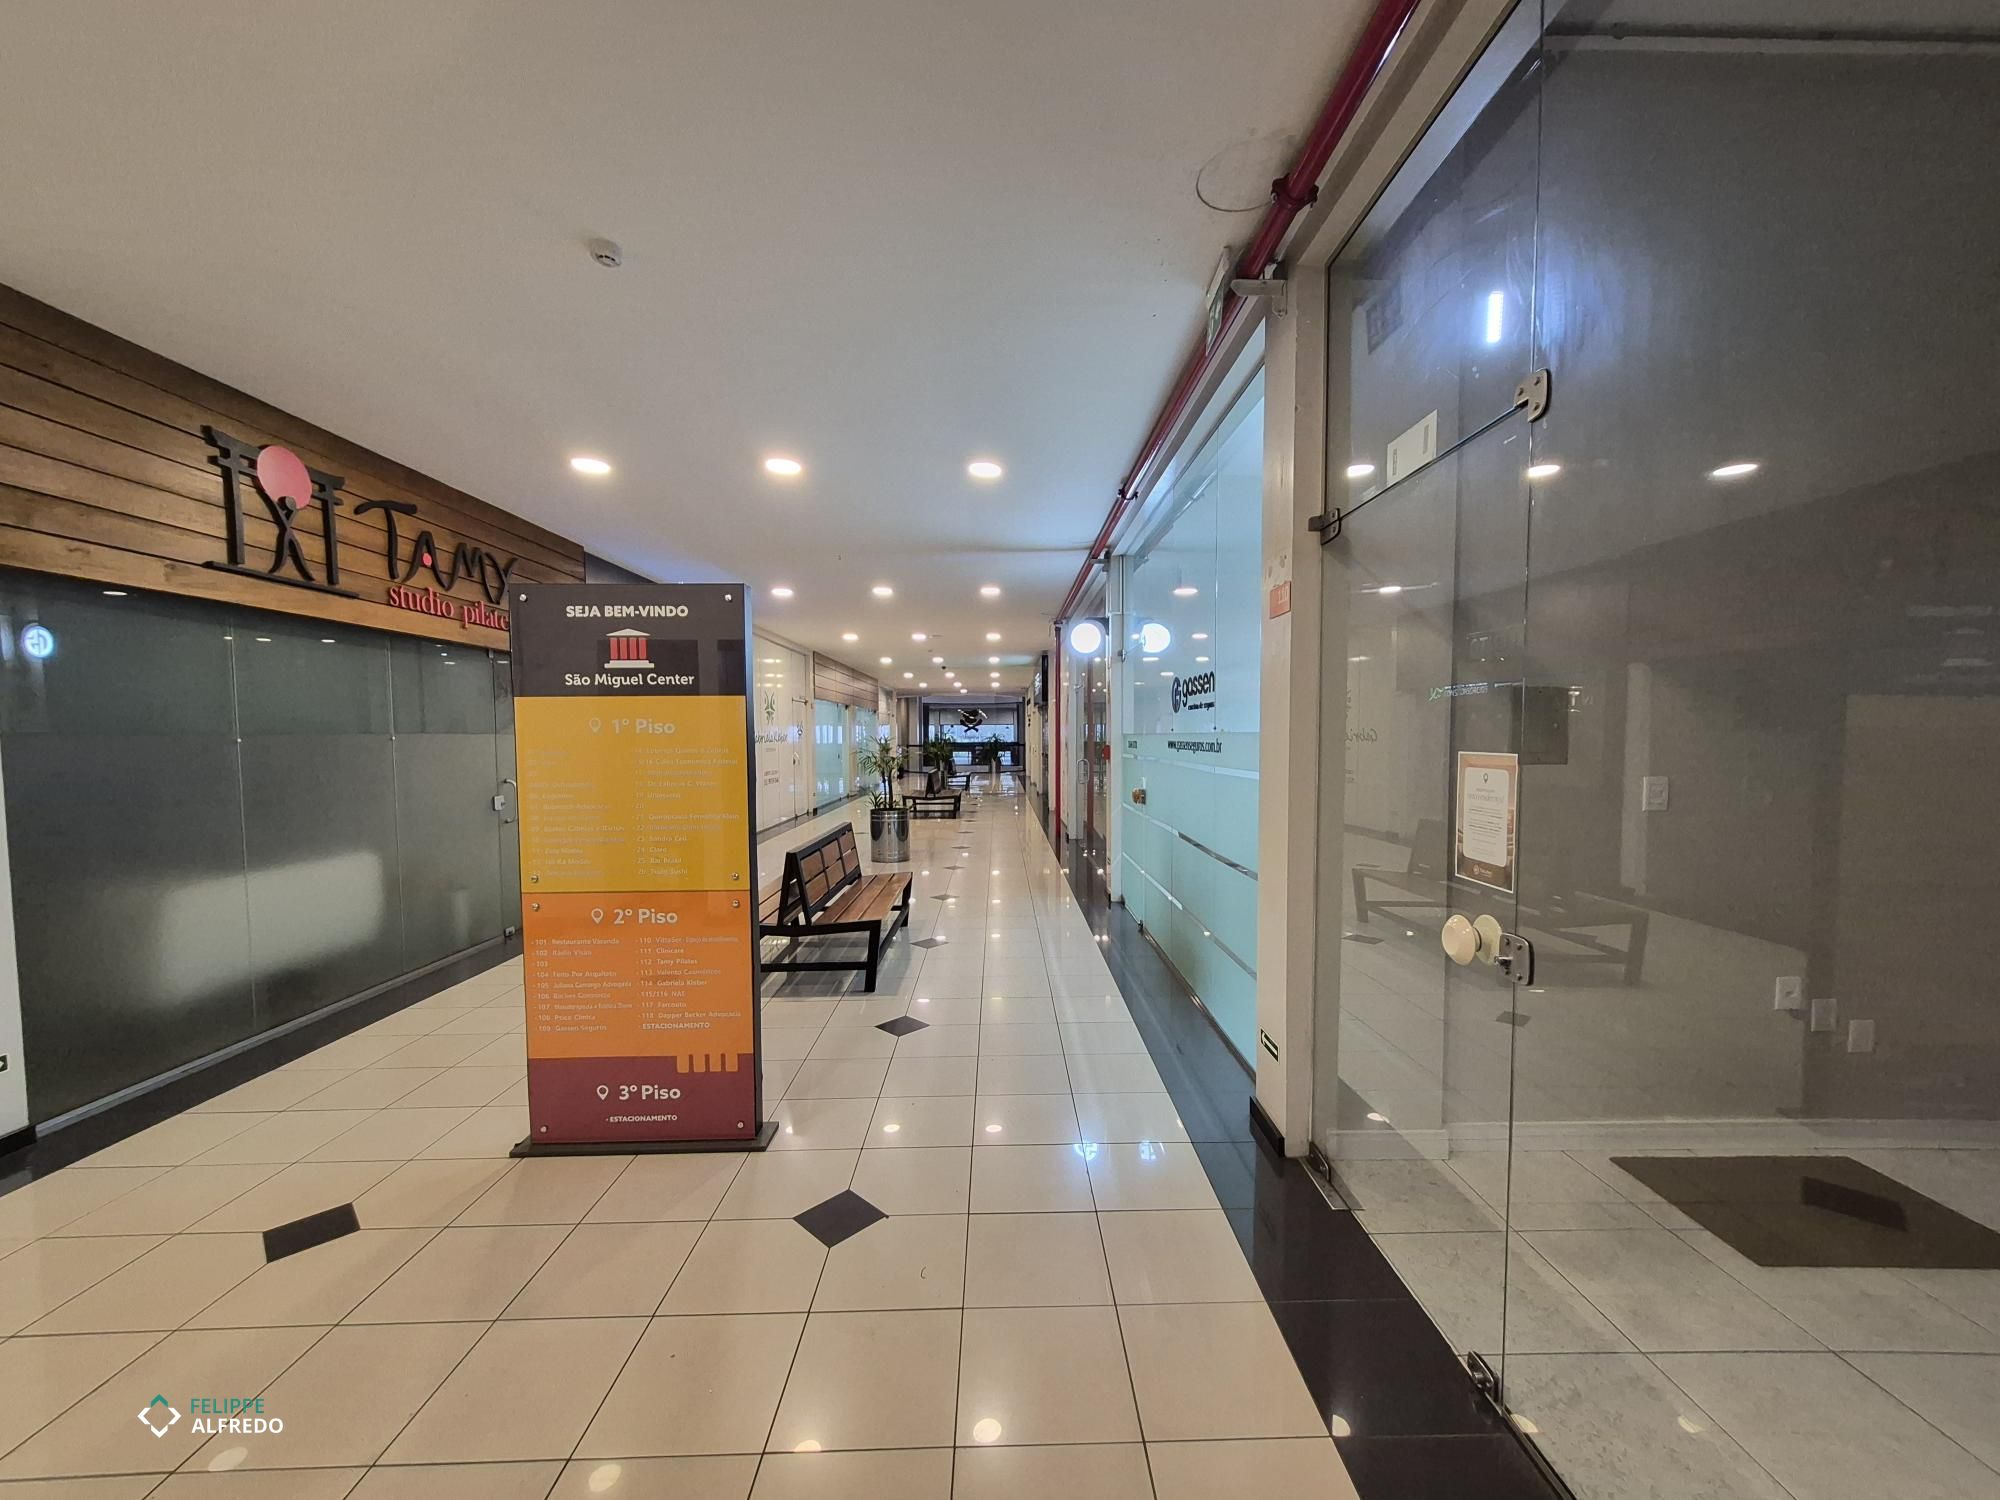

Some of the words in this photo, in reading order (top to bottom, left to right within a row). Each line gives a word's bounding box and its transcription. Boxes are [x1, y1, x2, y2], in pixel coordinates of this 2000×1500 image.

[354, 500, 518, 605] TAMY
[389, 585, 454, 618] studio
[463, 600, 509, 629] pilate
[566, 605, 601, 618] SEJA
[604, 605, 689, 618] BEM-VINDO
[565, 673, 590, 686] São
[594, 673, 644, 688] Miguel
[646, 673, 695, 686] Center
[1182, 671, 1215, 708] gassen
[612, 718, 629, 734] 1º
[635, 718, 675, 734] Piso
[614, 908, 633, 925] 2º
[638, 908, 678, 924] Piso
[656, 959, 674, 967] Tamy
[642, 1022, 711, 1030] ESTACIONAMENTO
[619, 1084, 638, 1101] 3º
[641, 1084, 681, 1100] Piso
[609, 1114, 678, 1122] ESTACIONAMENTO
